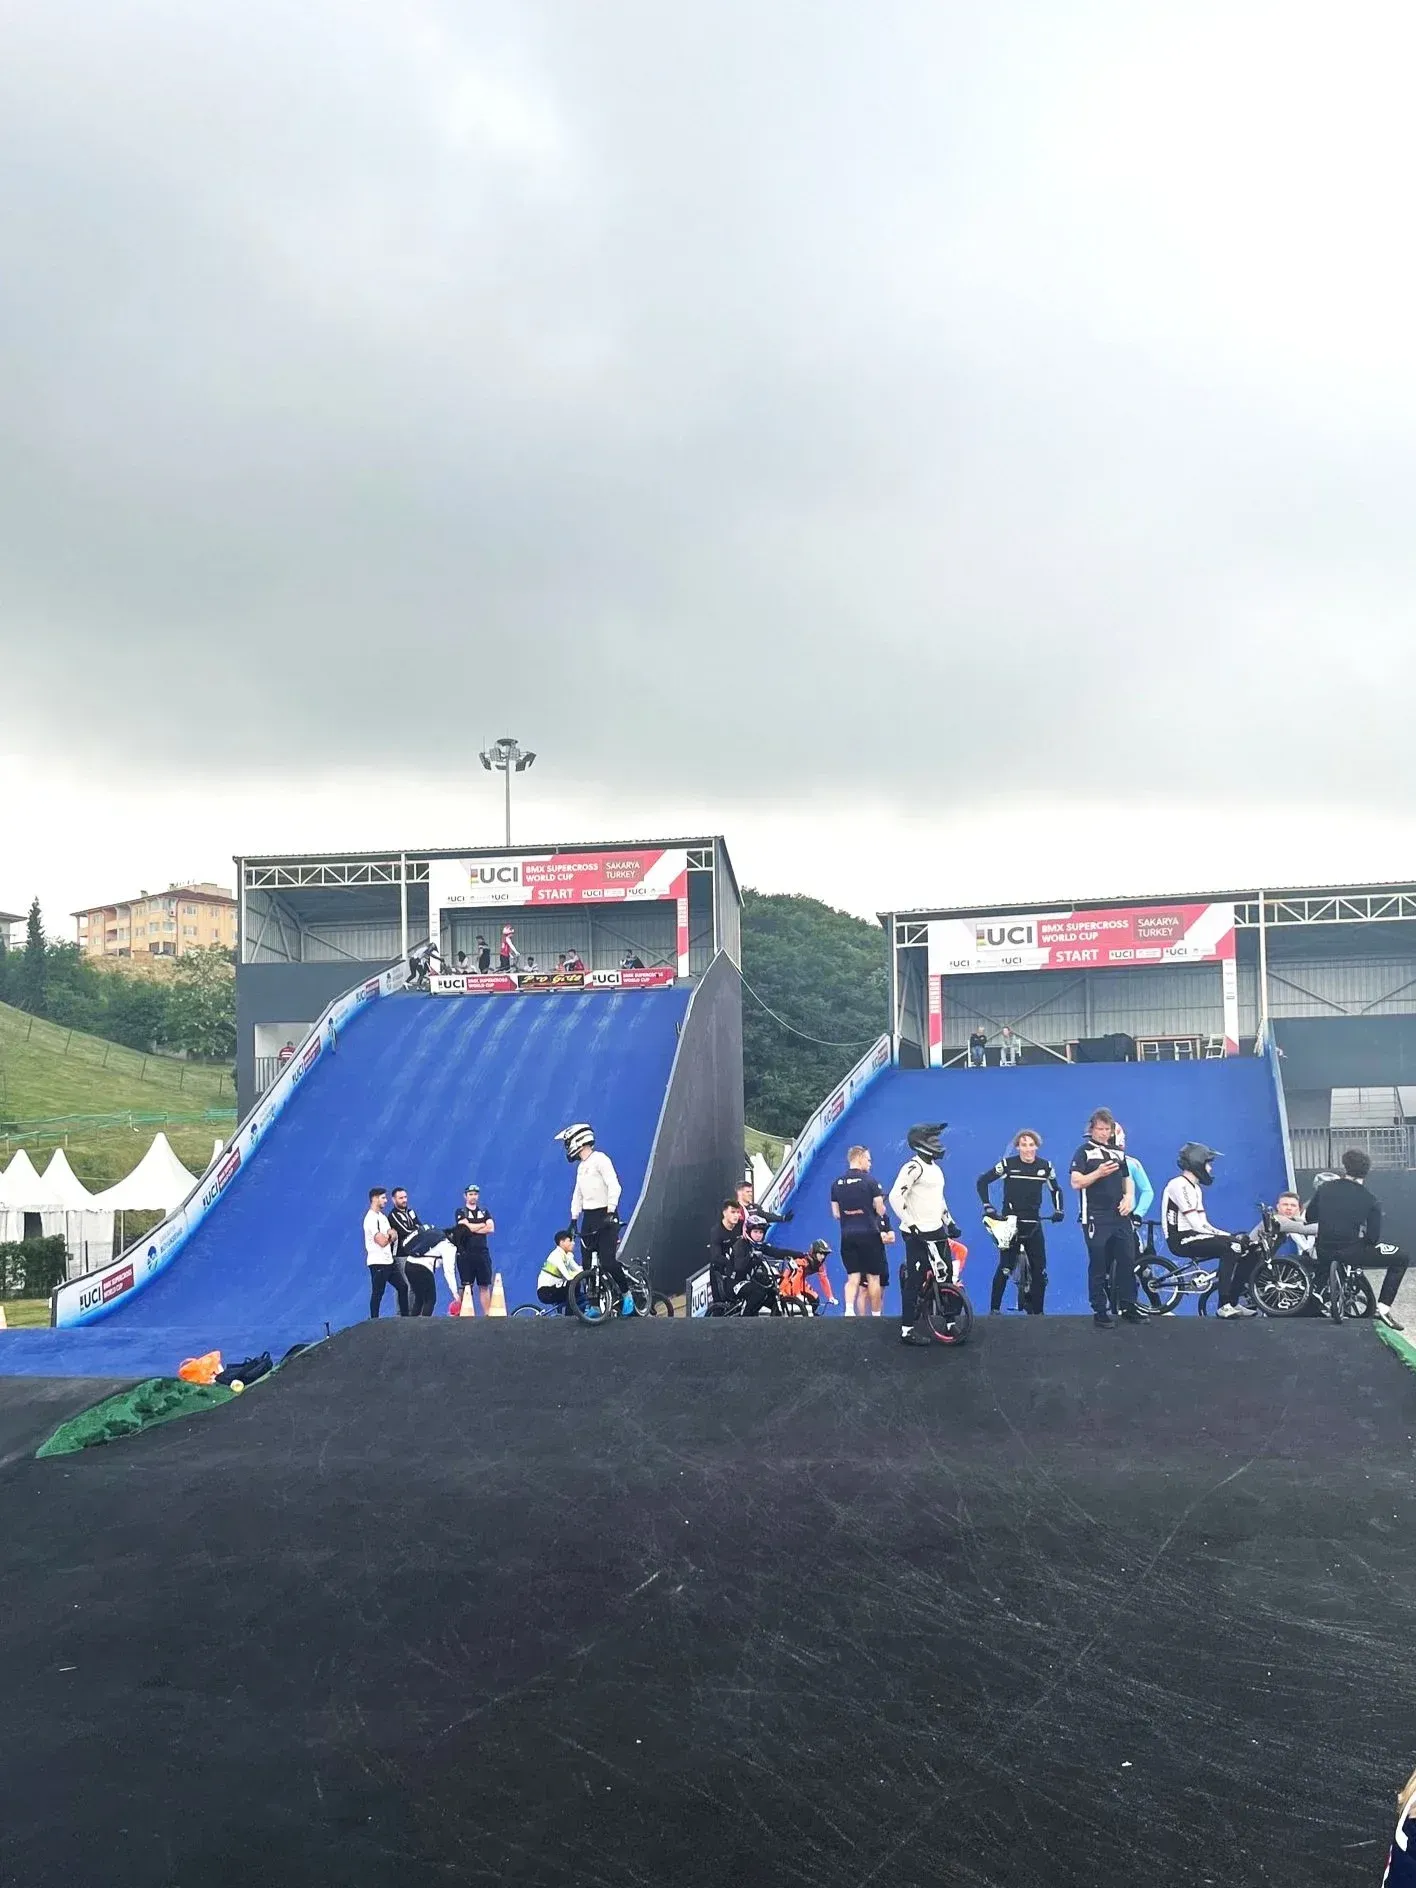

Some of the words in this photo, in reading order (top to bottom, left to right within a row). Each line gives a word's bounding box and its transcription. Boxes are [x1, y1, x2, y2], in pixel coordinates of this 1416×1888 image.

[525, 865, 545, 873] BMX
[547, 863, 599, 873] SUPERCROSS
[605, 861, 640, 870] SAKARYA
[480, 867, 518, 883] UCI
[525, 873, 556, 882] WORLD
[557, 873, 574, 881] CUP
[606, 871, 636, 879] TURKEY
[538, 888, 575, 900] START
[1042, 923, 1063, 933] BMX
[1066, 920, 1129, 932] SUPERCROSS
[1137, 918, 1180, 928] SAKARYA
[987, 926, 1032, 946] UCI
[1138, 928, 1174, 937] TURKEY
[1042, 933, 1077, 944] WORLD
[1079, 932, 1099, 942] CUP
[1056, 949, 1099, 963] START
[1115, 950, 1132, 958] UCI
[1170, 948, 1187, 956] UCI
[597, 974, 620, 983] UCI
[443, 979, 465, 989] UCI
[83, 1285, 102, 1309] UCI
[694, 1288, 707, 1311] UCI
